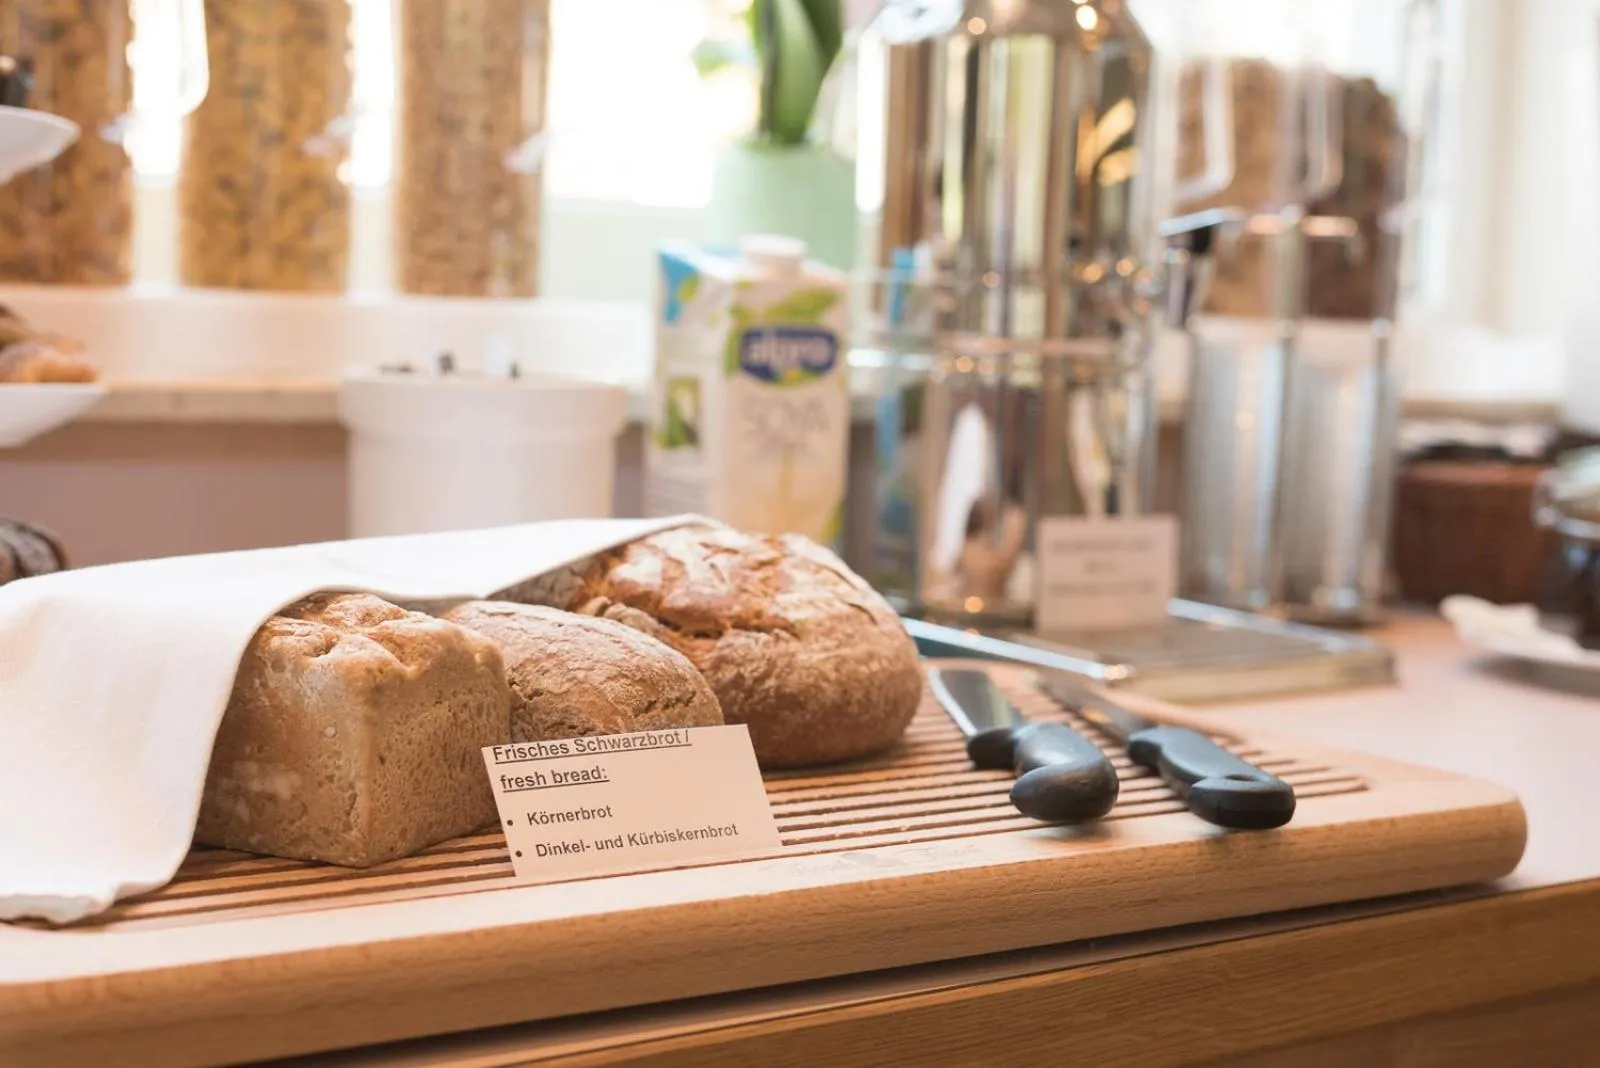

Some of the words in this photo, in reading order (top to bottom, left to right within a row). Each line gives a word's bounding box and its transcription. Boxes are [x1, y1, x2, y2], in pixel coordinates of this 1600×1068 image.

[493, 739, 570, 762] Frisches
[575, 729, 681, 753] Schwarzbrot
[500, 771, 547, 790] fresh
[551, 765, 609, 784] bread:
[527, 804, 614, 826] Körnerbrot
[536, 838, 592, 858] Dinkel-
[594, 830, 625, 850] und
[627, 823, 739, 848] Kürbiskernbrot
